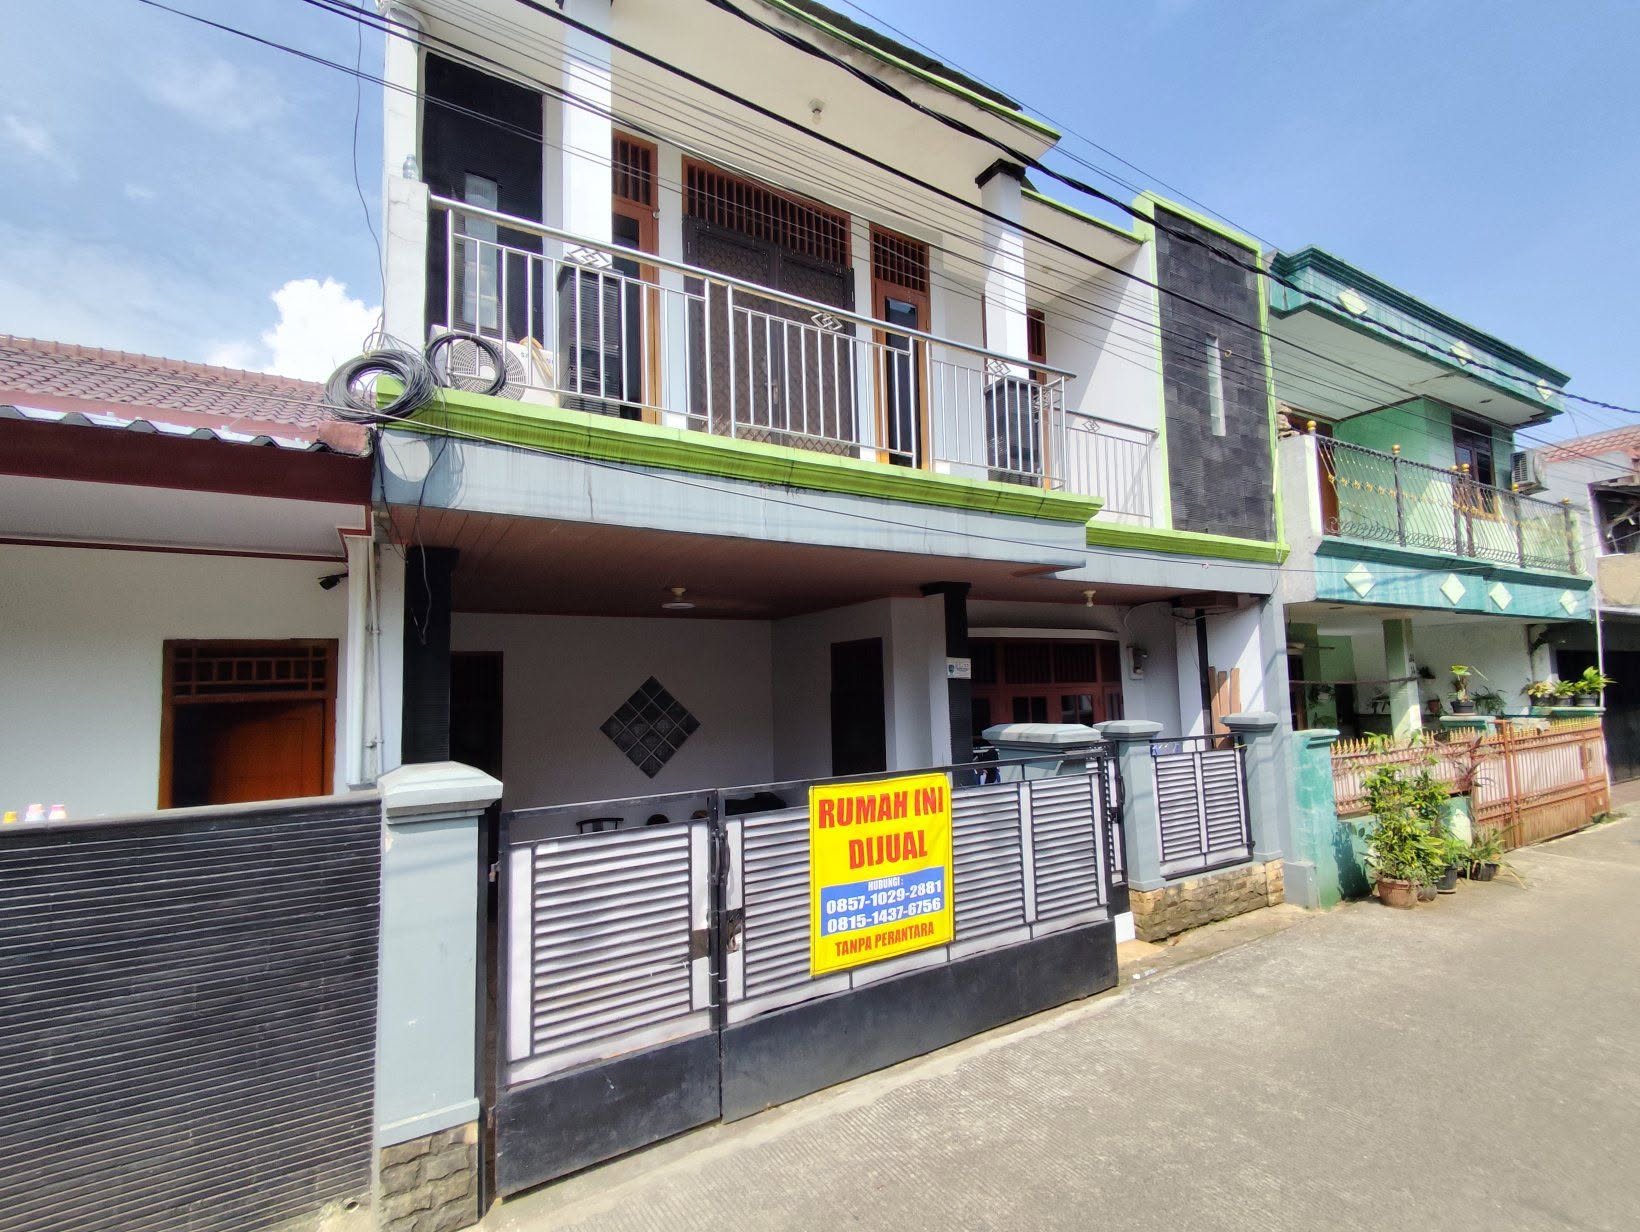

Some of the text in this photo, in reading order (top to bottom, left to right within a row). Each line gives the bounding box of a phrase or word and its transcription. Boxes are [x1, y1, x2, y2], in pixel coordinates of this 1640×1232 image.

[819, 786, 943, 828] RUMAH INI
[849, 830, 927, 869] DIJUAL
[827, 881, 941, 914] 0857-1029-2881
[828, 898, 940, 933] 0815-1437-6756
[835, 921, 934, 957] TANPA PERANTARA
